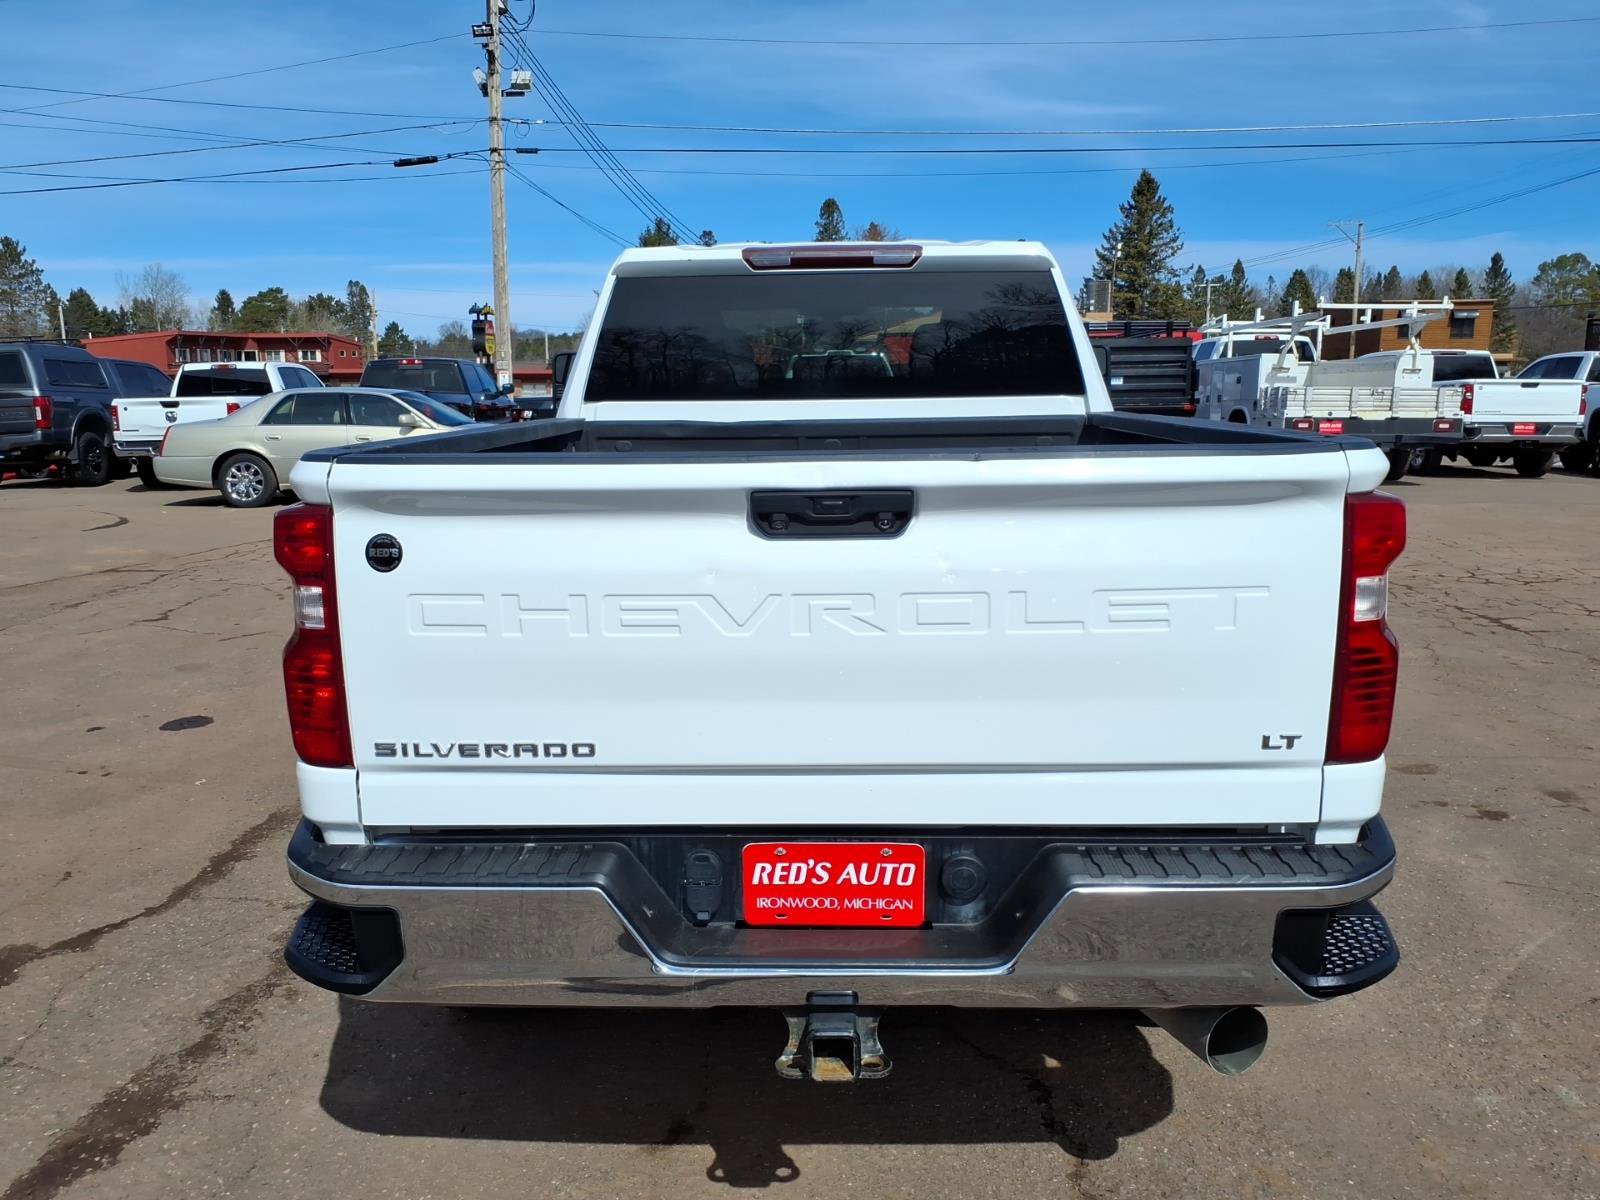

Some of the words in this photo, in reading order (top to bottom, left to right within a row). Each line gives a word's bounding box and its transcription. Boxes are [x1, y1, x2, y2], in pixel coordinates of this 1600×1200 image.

[369, 547, 400, 558] RED'S
[407, 585, 1270, 638] CHEVROLET
[374, 742, 597, 758] SILVERADO
[1261, 734, 1303, 750] LT
[751, 858, 832, 886] RED'S
[836, 862, 916, 886] AUTO
[756, 896, 841, 911] IRONWOOD,
[843, 897, 913, 910] MICHIGAN
